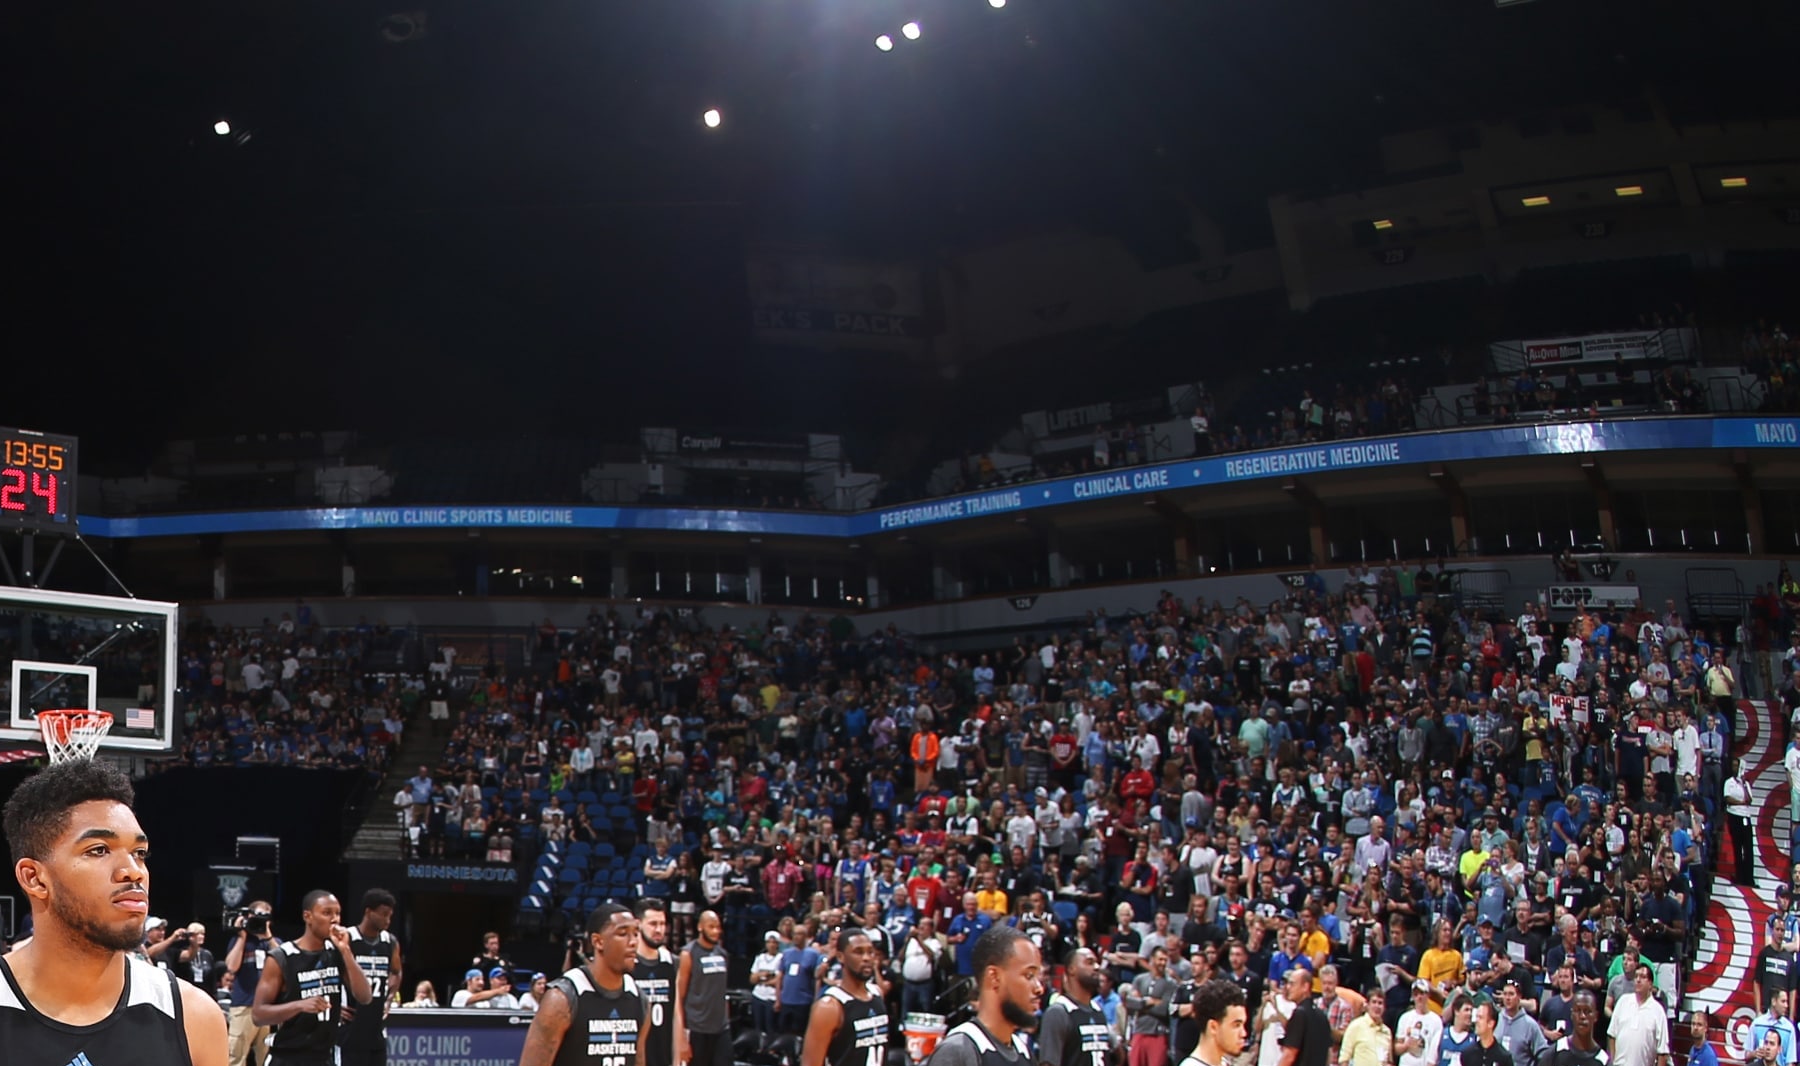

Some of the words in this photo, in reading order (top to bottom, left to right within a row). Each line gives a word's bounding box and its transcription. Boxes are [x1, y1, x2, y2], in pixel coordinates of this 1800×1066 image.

[833, 312, 905, 336] PACK
[1754, 423, 1798, 443] MAYO
[4, 439, 64, 471] 13:55
[1225, 450, 1327, 478] REGENERATIVE
[1330, 443, 1400, 466] MEDICINE
[0, 468, 58, 515] 24
[1073, 475, 1132, 498] CLINICAL
[1134, 470, 1169, 489] CARE
[361, 511, 399, 525] MAYO
[403, 510, 447, 525] CLINIC
[450, 509, 503, 524] SPORTS
[506, 509, 573, 523] MEDICINE
[880, 501, 964, 529] PERFORMANCE
[966, 491, 1022, 515] TRAINING
[1551, 588, 1592, 603] POPP
[407, 864, 518, 883] MINNESOTA
[588, 1019, 638, 1033] MINNESOTA
[416, 1036, 472, 1056] CLINIC
[587, 1043, 637, 1056] BASKETBALL
